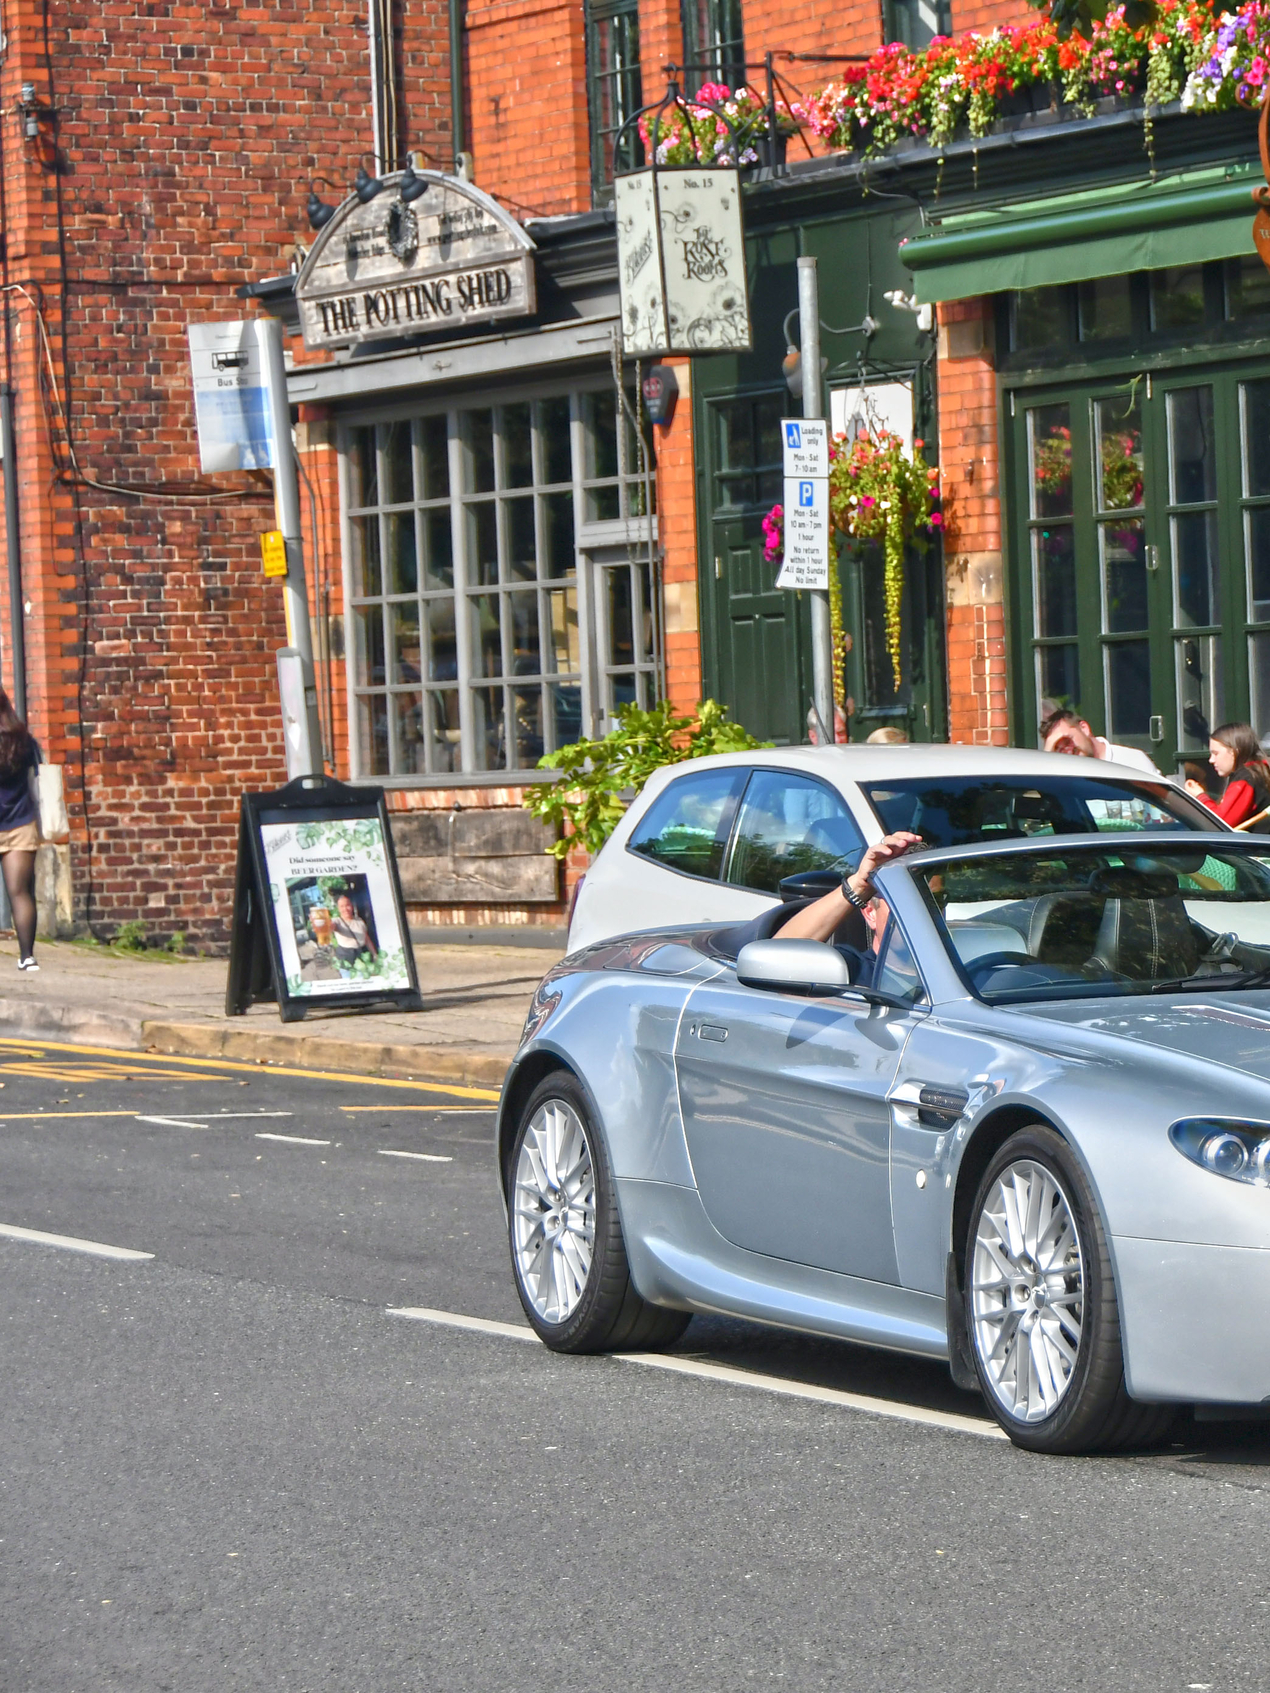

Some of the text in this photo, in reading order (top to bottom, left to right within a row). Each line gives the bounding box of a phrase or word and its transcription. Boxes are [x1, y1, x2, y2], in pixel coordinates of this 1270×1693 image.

[683, 177, 714, 189] No. 15
[316, 268, 511, 336] THE POTTING SHED
[217, 378, 233, 387] Bus
[801, 427, 823, 436] Loading
[807, 438, 818, 446] only
[793, 453, 805, 461] Mon
[809, 453, 819, 461] Sat
[793, 509, 805, 517] Mon
[809, 509, 819, 518] Sat
[790, 520, 797, 529] 10
[813, 522, 822, 530] pm
[802, 533, 814, 541] hour
[793, 546, 802, 554] No
[811, 557, 823, 565] hour
[784, 565, 826, 576] All day Sunday
[795, 576, 818, 585] No limit
[289, 856, 304, 864] Did
[291, 864, 358, 875] BEER GARDEN?
